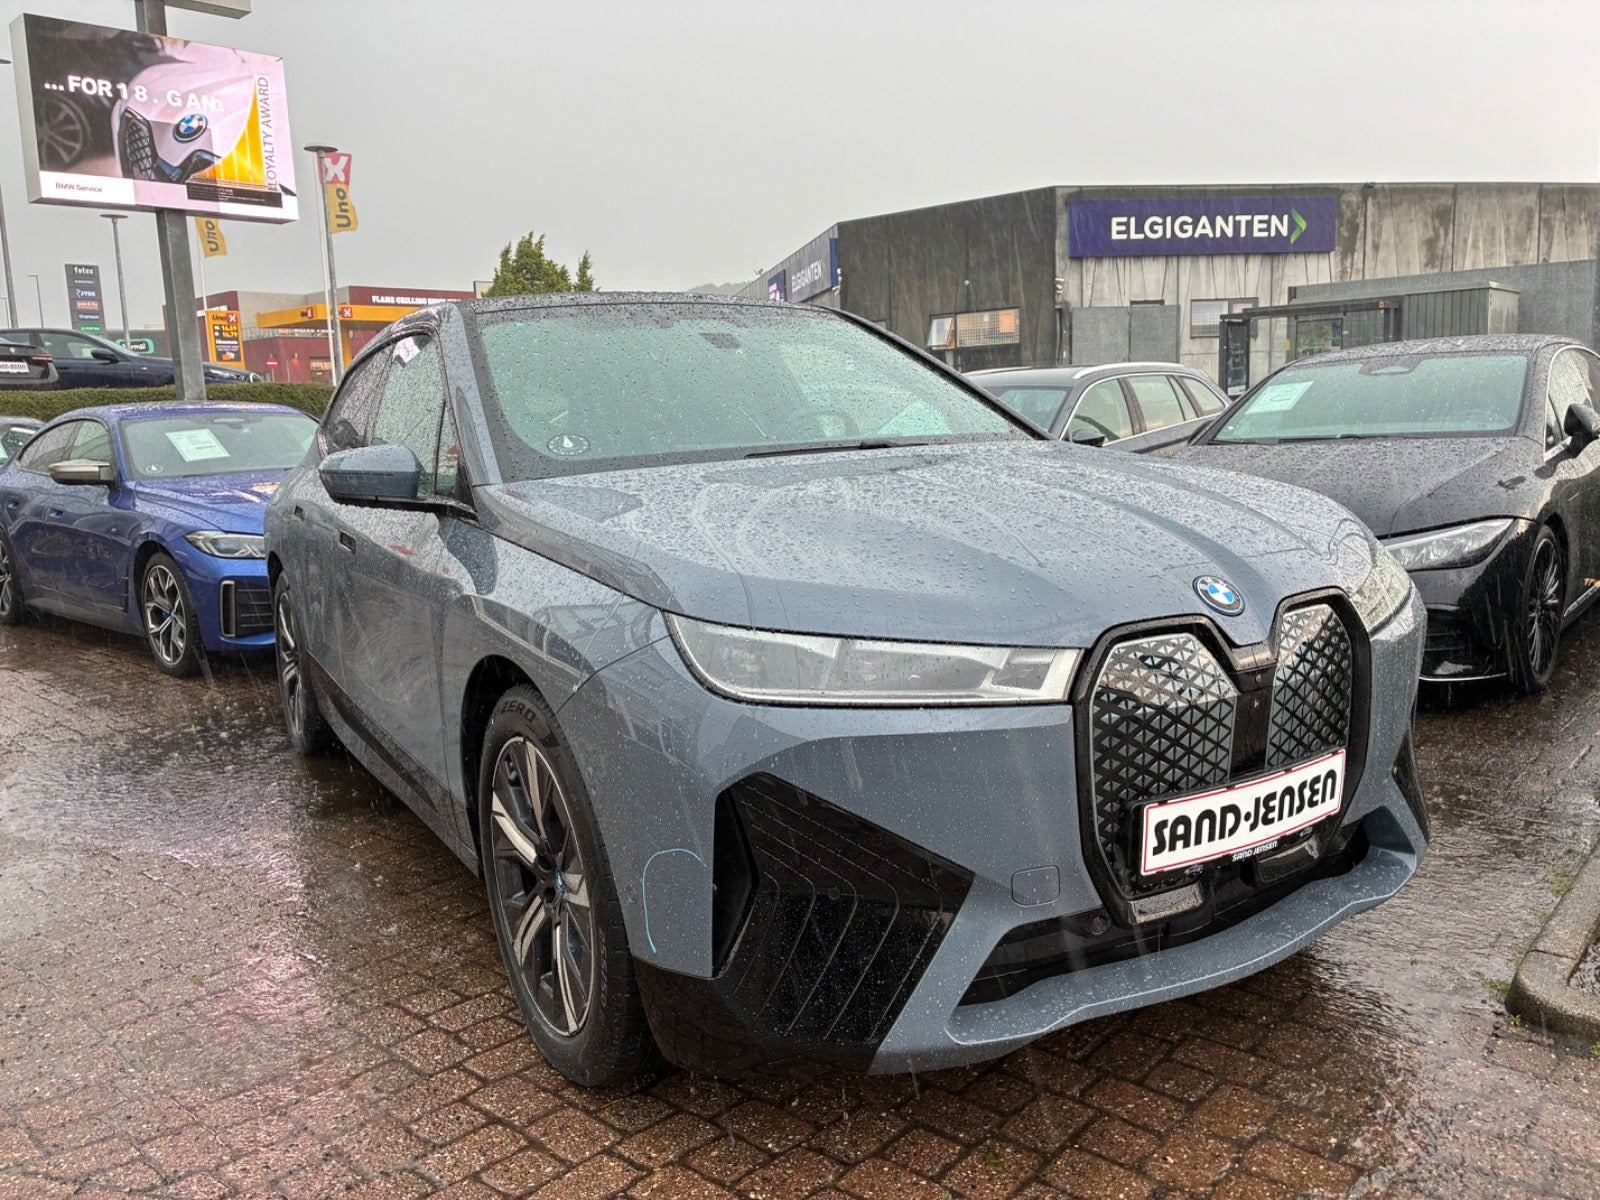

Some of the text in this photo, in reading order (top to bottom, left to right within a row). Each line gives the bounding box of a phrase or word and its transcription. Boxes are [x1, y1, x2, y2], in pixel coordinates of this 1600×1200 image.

[257, 77, 273, 129] AWARD
[55, 182, 103, 193] BMW Service
[1110, 212, 1290, 241] ELGIGANTEN
[791, 259, 823, 293] ELGIGANTEN
[501, 699, 538, 723] ZERO
